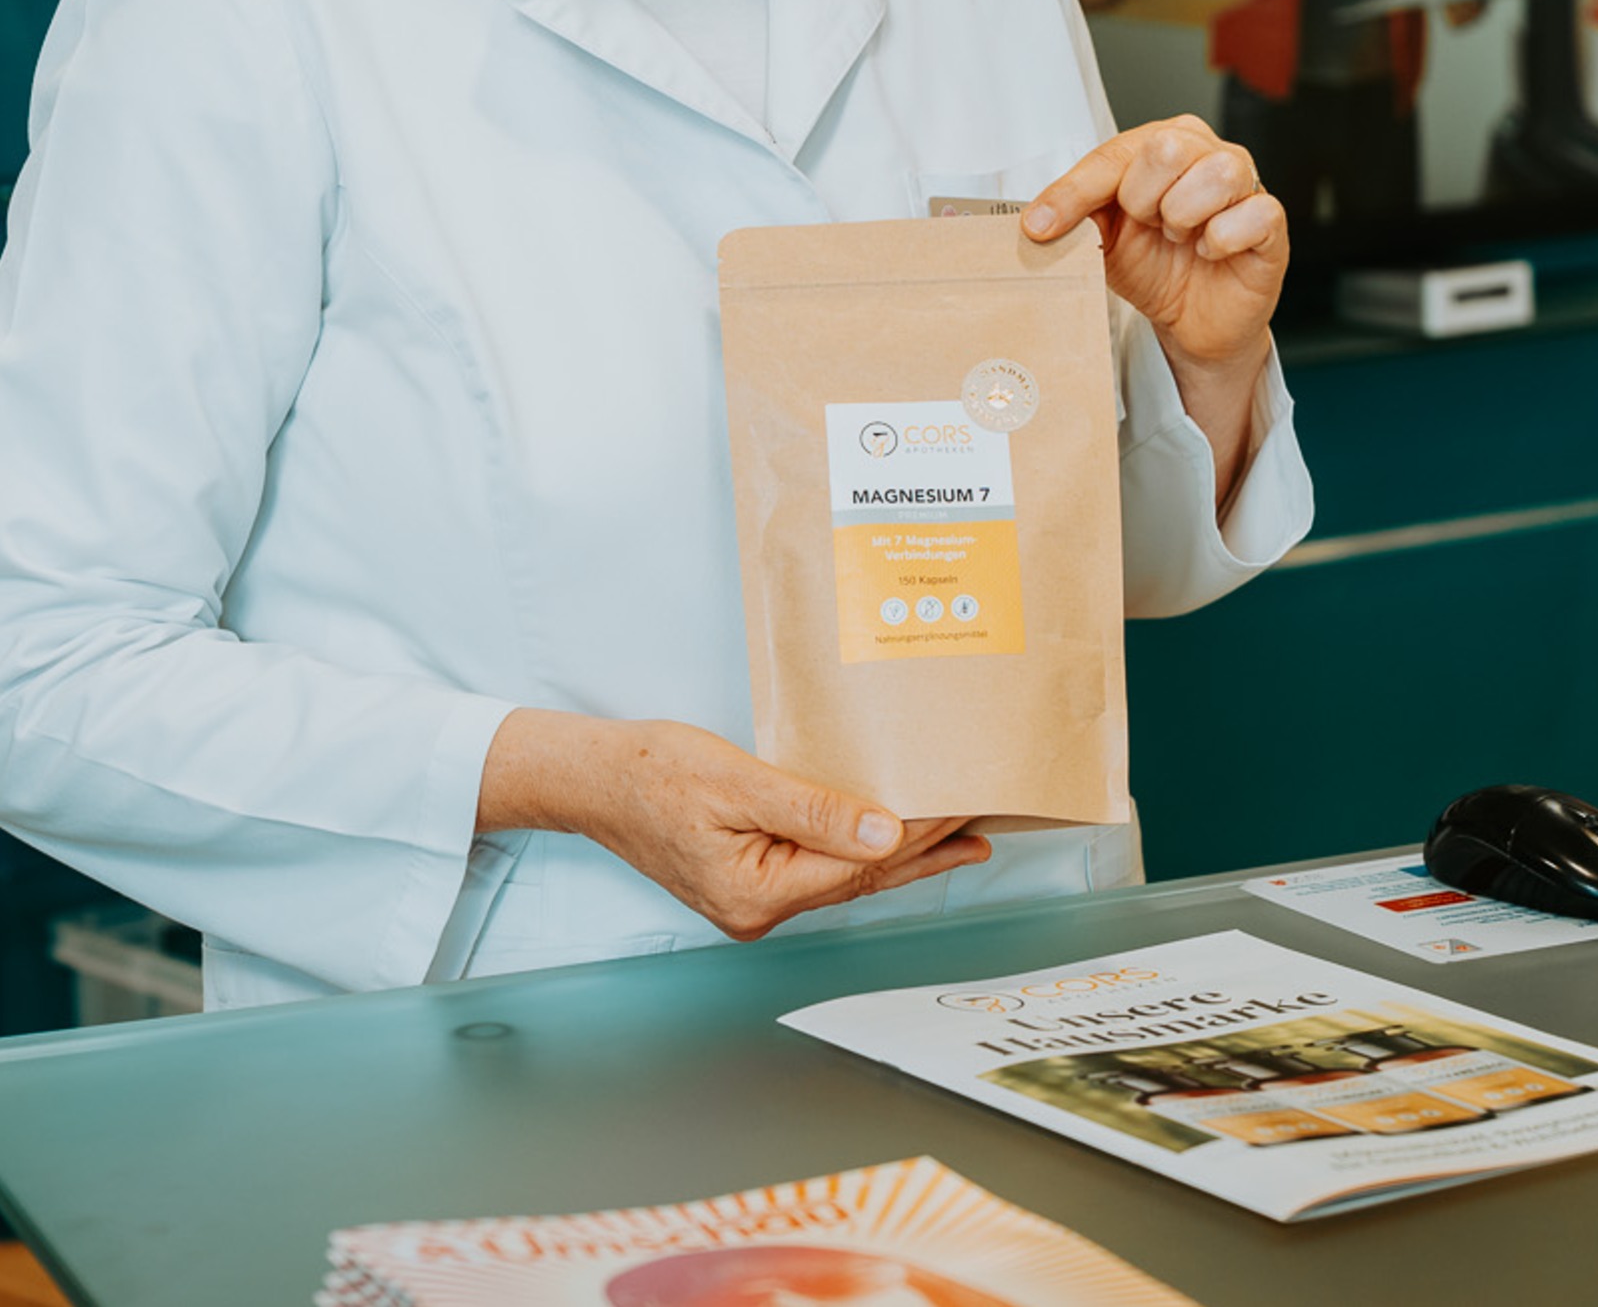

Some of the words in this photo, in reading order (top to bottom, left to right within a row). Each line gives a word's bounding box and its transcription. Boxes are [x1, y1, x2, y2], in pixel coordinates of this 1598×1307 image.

[904, 425, 973, 444] CORS
[905, 446, 975, 454] APOTHEKEN
[852, 489, 974, 504] MAGNESIUM
[979, 488, 991, 502] 7
[872, 535, 891, 547] Mit
[895, 535, 902, 546] 7
[885, 550, 967, 562] Verbindungen
[899, 575, 916, 586] 150
[919, 575, 958, 585] Kapseln
[1021, 966, 1159, 998] CORS
[1008, 992, 1231, 1032] Unsere
[977, 992, 1338, 1056] Hausmarke
